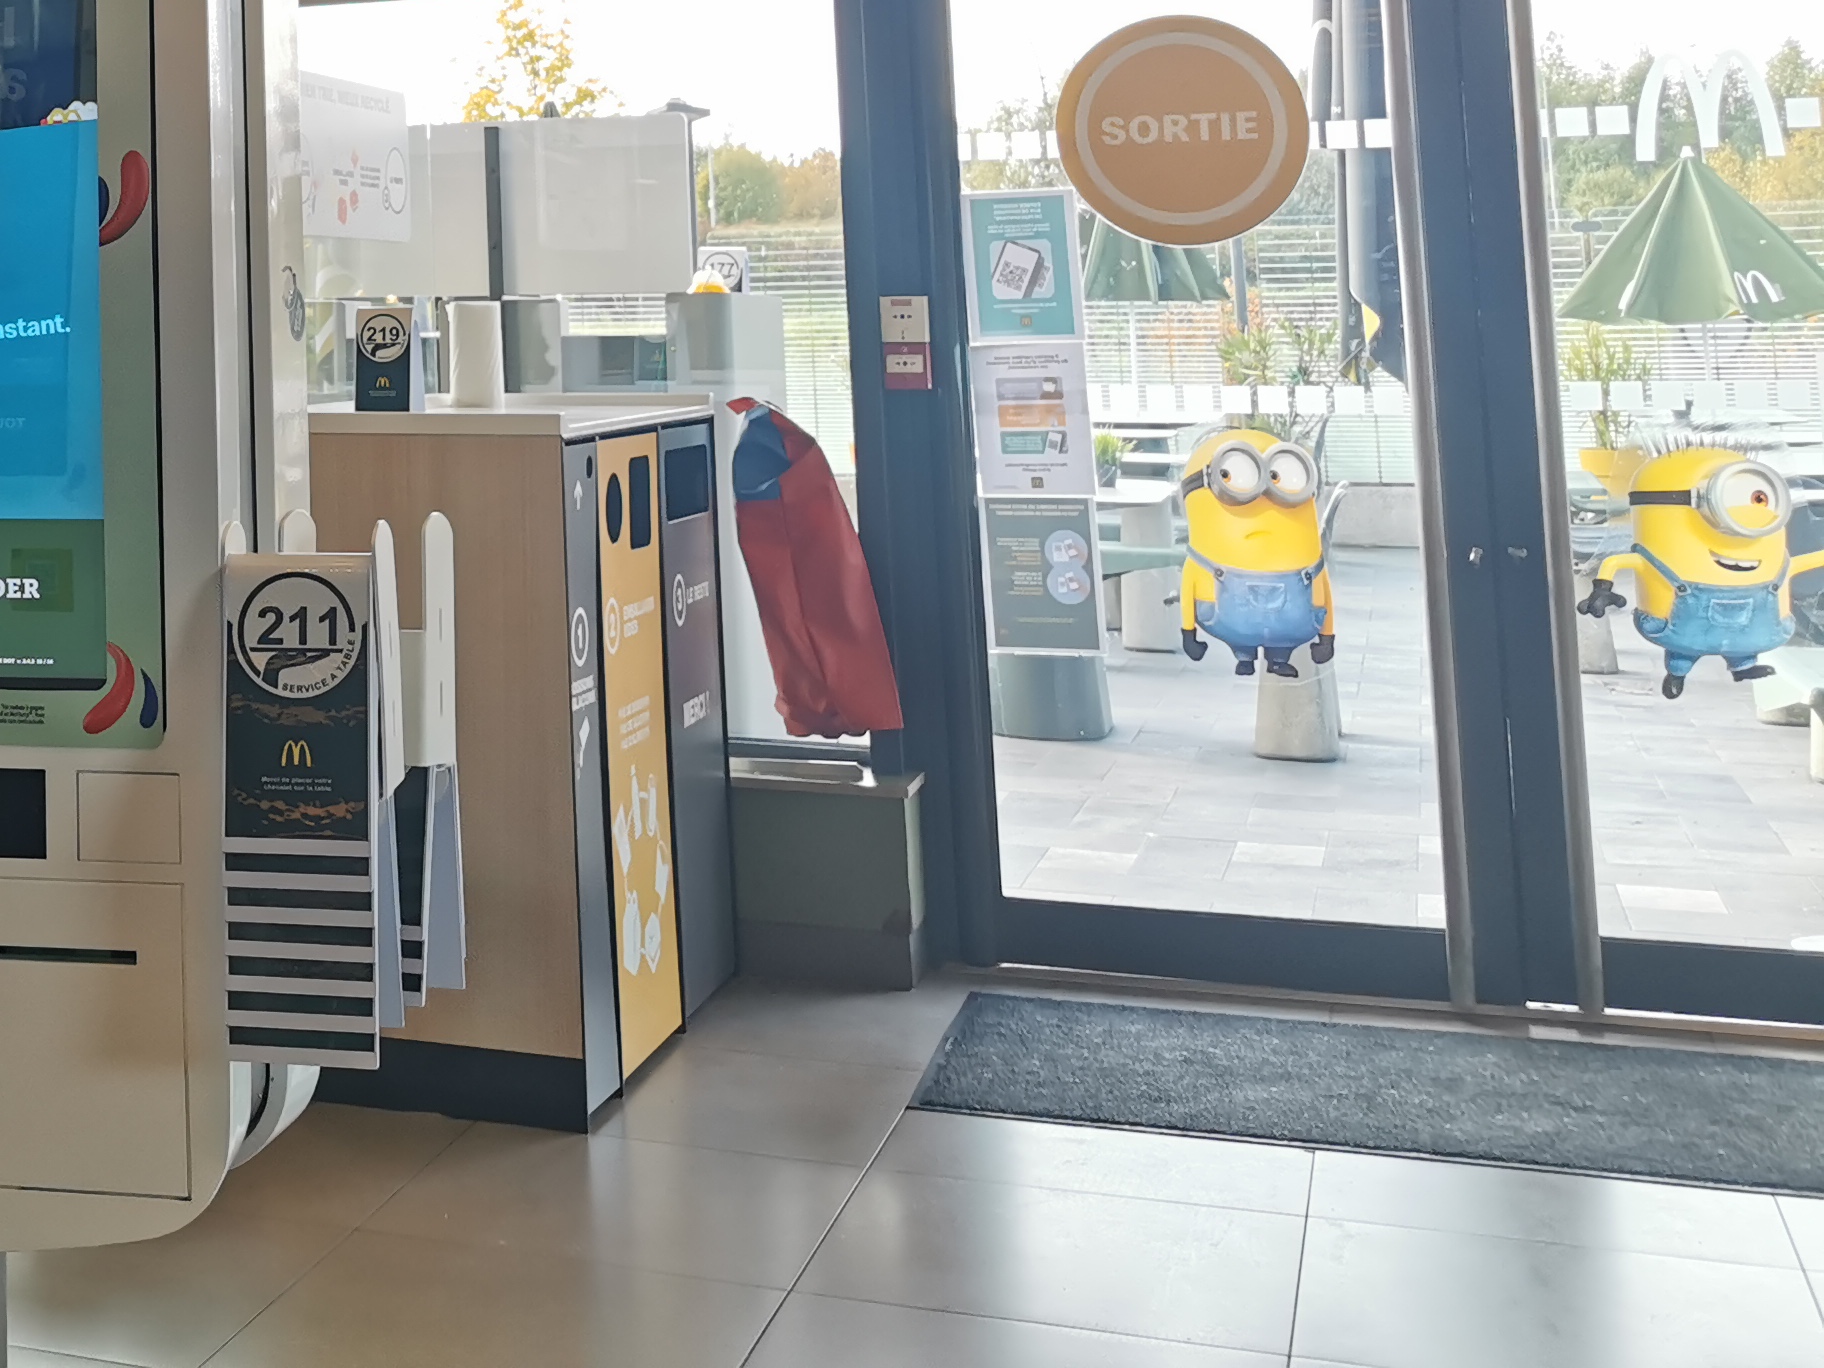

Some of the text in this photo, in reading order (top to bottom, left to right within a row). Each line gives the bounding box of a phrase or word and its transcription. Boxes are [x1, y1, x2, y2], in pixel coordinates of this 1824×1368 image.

[1100, 110, 1260, 146] SORTIE
[367, 326, 399, 342] 219
[256, 605, 338, 646] 211
[282, 677, 330, 694] SERVICE
[335, 638, 356, 673] TABLE
